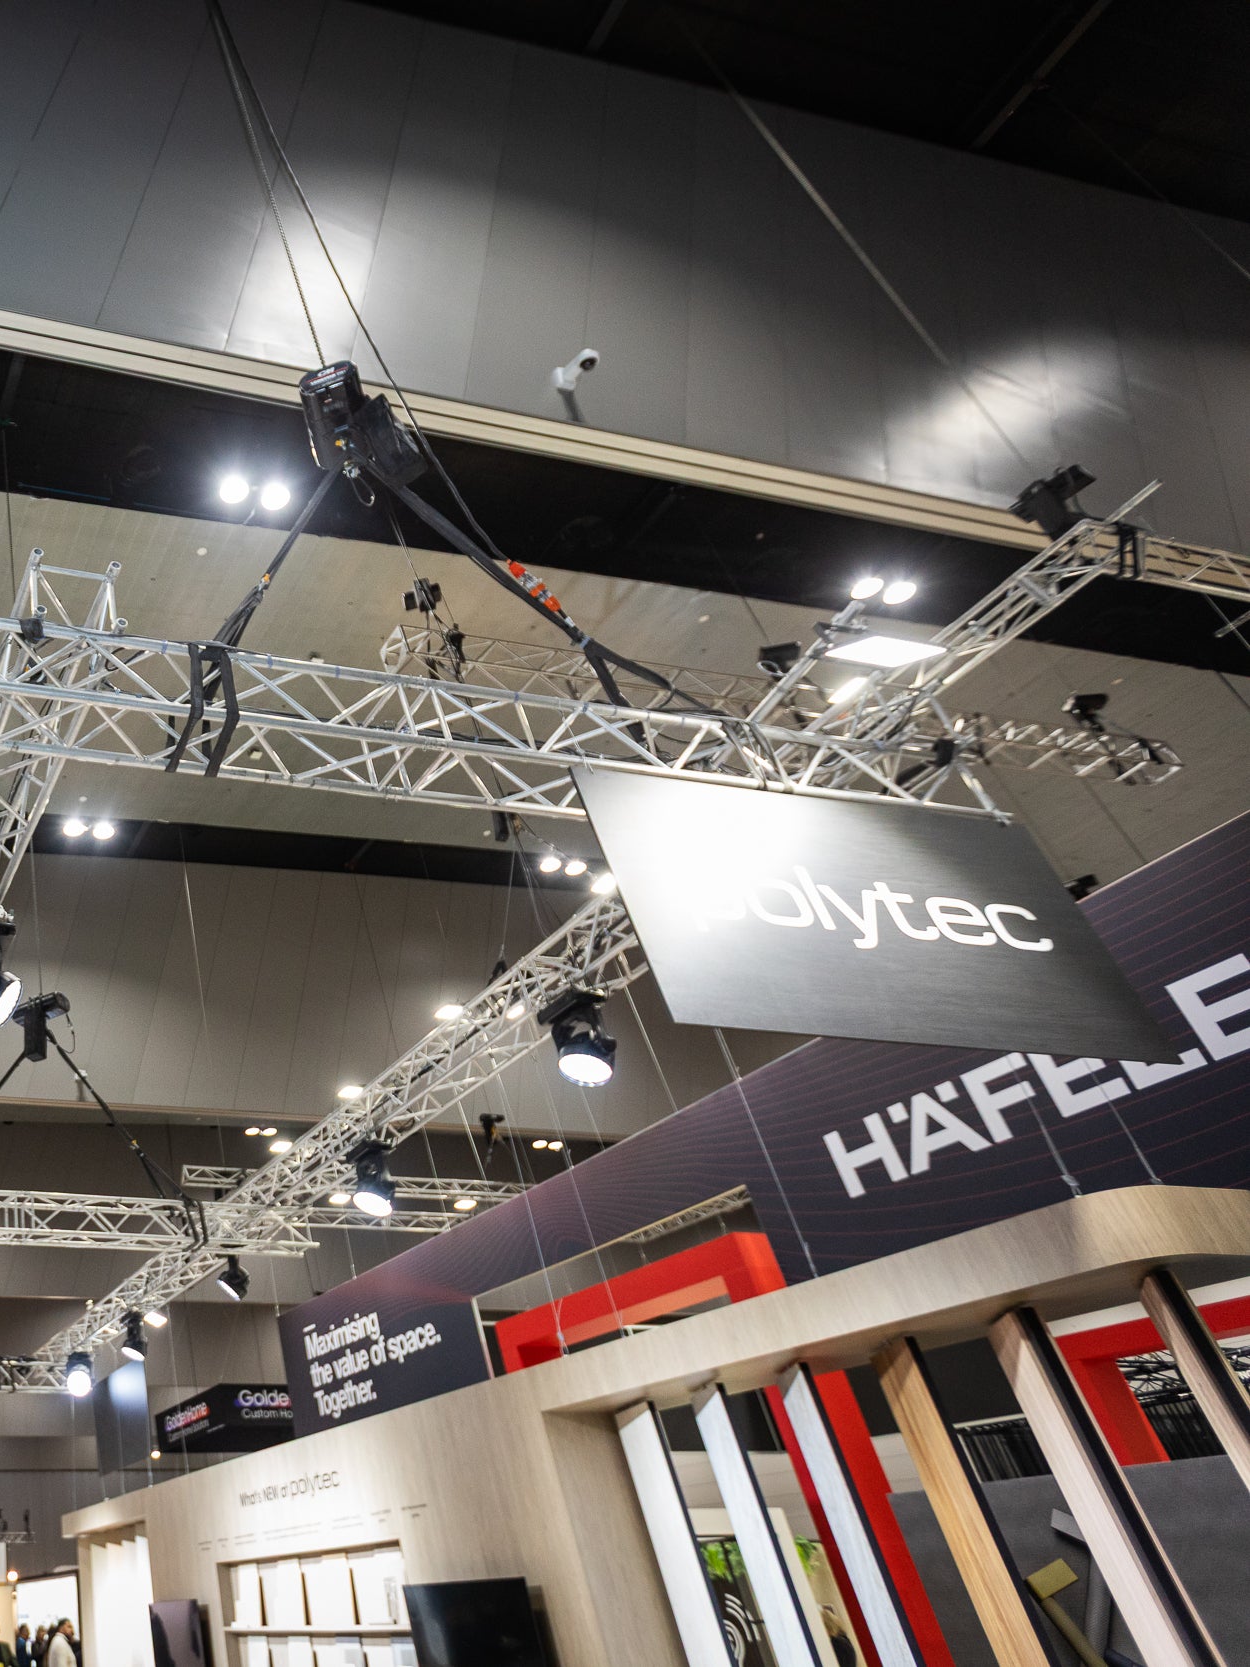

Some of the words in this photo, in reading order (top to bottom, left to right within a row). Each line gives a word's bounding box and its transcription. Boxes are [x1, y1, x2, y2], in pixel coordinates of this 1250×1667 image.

[304, 1312, 380, 1360] Maximising
[310, 1361, 334, 1388] the
[333, 1348, 370, 1379] value
[369, 1334, 386, 1366] of
[386, 1322, 442, 1364] space.
[241, 1408, 278, 1419] Custom
[313, 1379, 378, 1419] Together.
[263, 1485, 280, 1502] NEW
[290, 1470, 340, 1500] polytec
